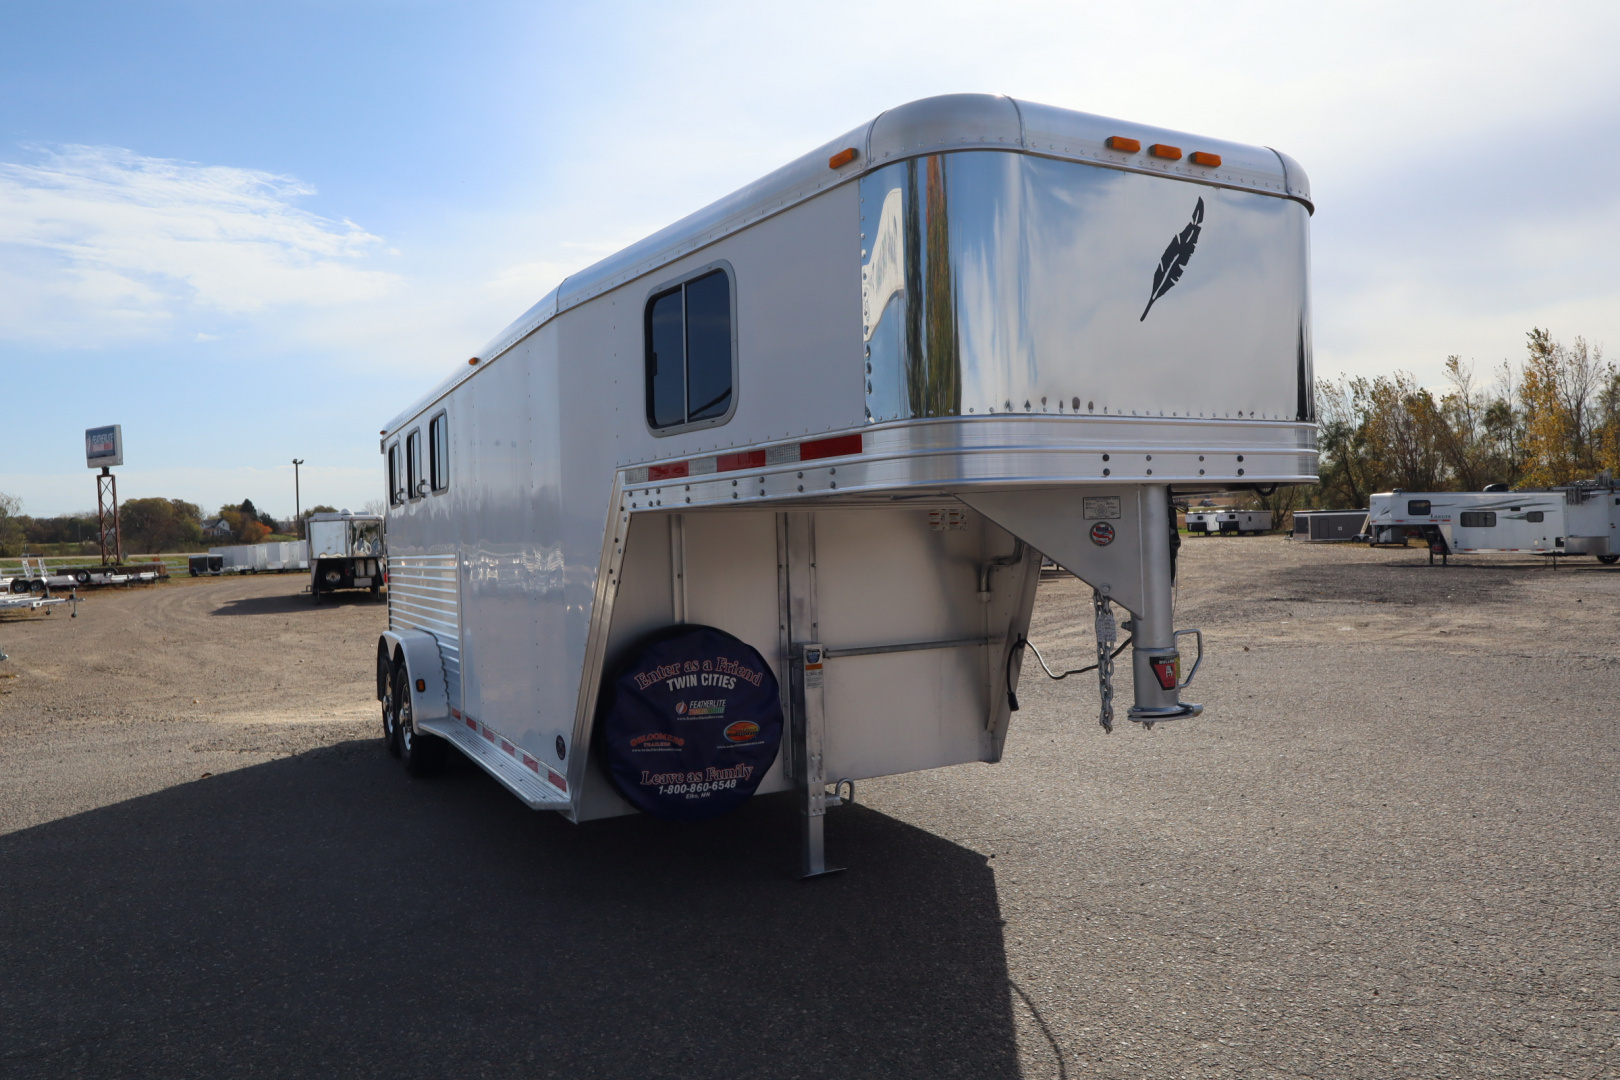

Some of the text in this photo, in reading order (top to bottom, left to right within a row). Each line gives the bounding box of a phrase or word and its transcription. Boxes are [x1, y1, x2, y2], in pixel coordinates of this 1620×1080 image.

[634, 656, 763, 691] Enter as a Friend
[666, 673, 737, 692] TWIN CITIES
[690, 699, 726, 708] FEATHERLITE
[639, 763, 754, 786] Leave as Family
[658, 779, 737, 795] 1-800-860-6548
